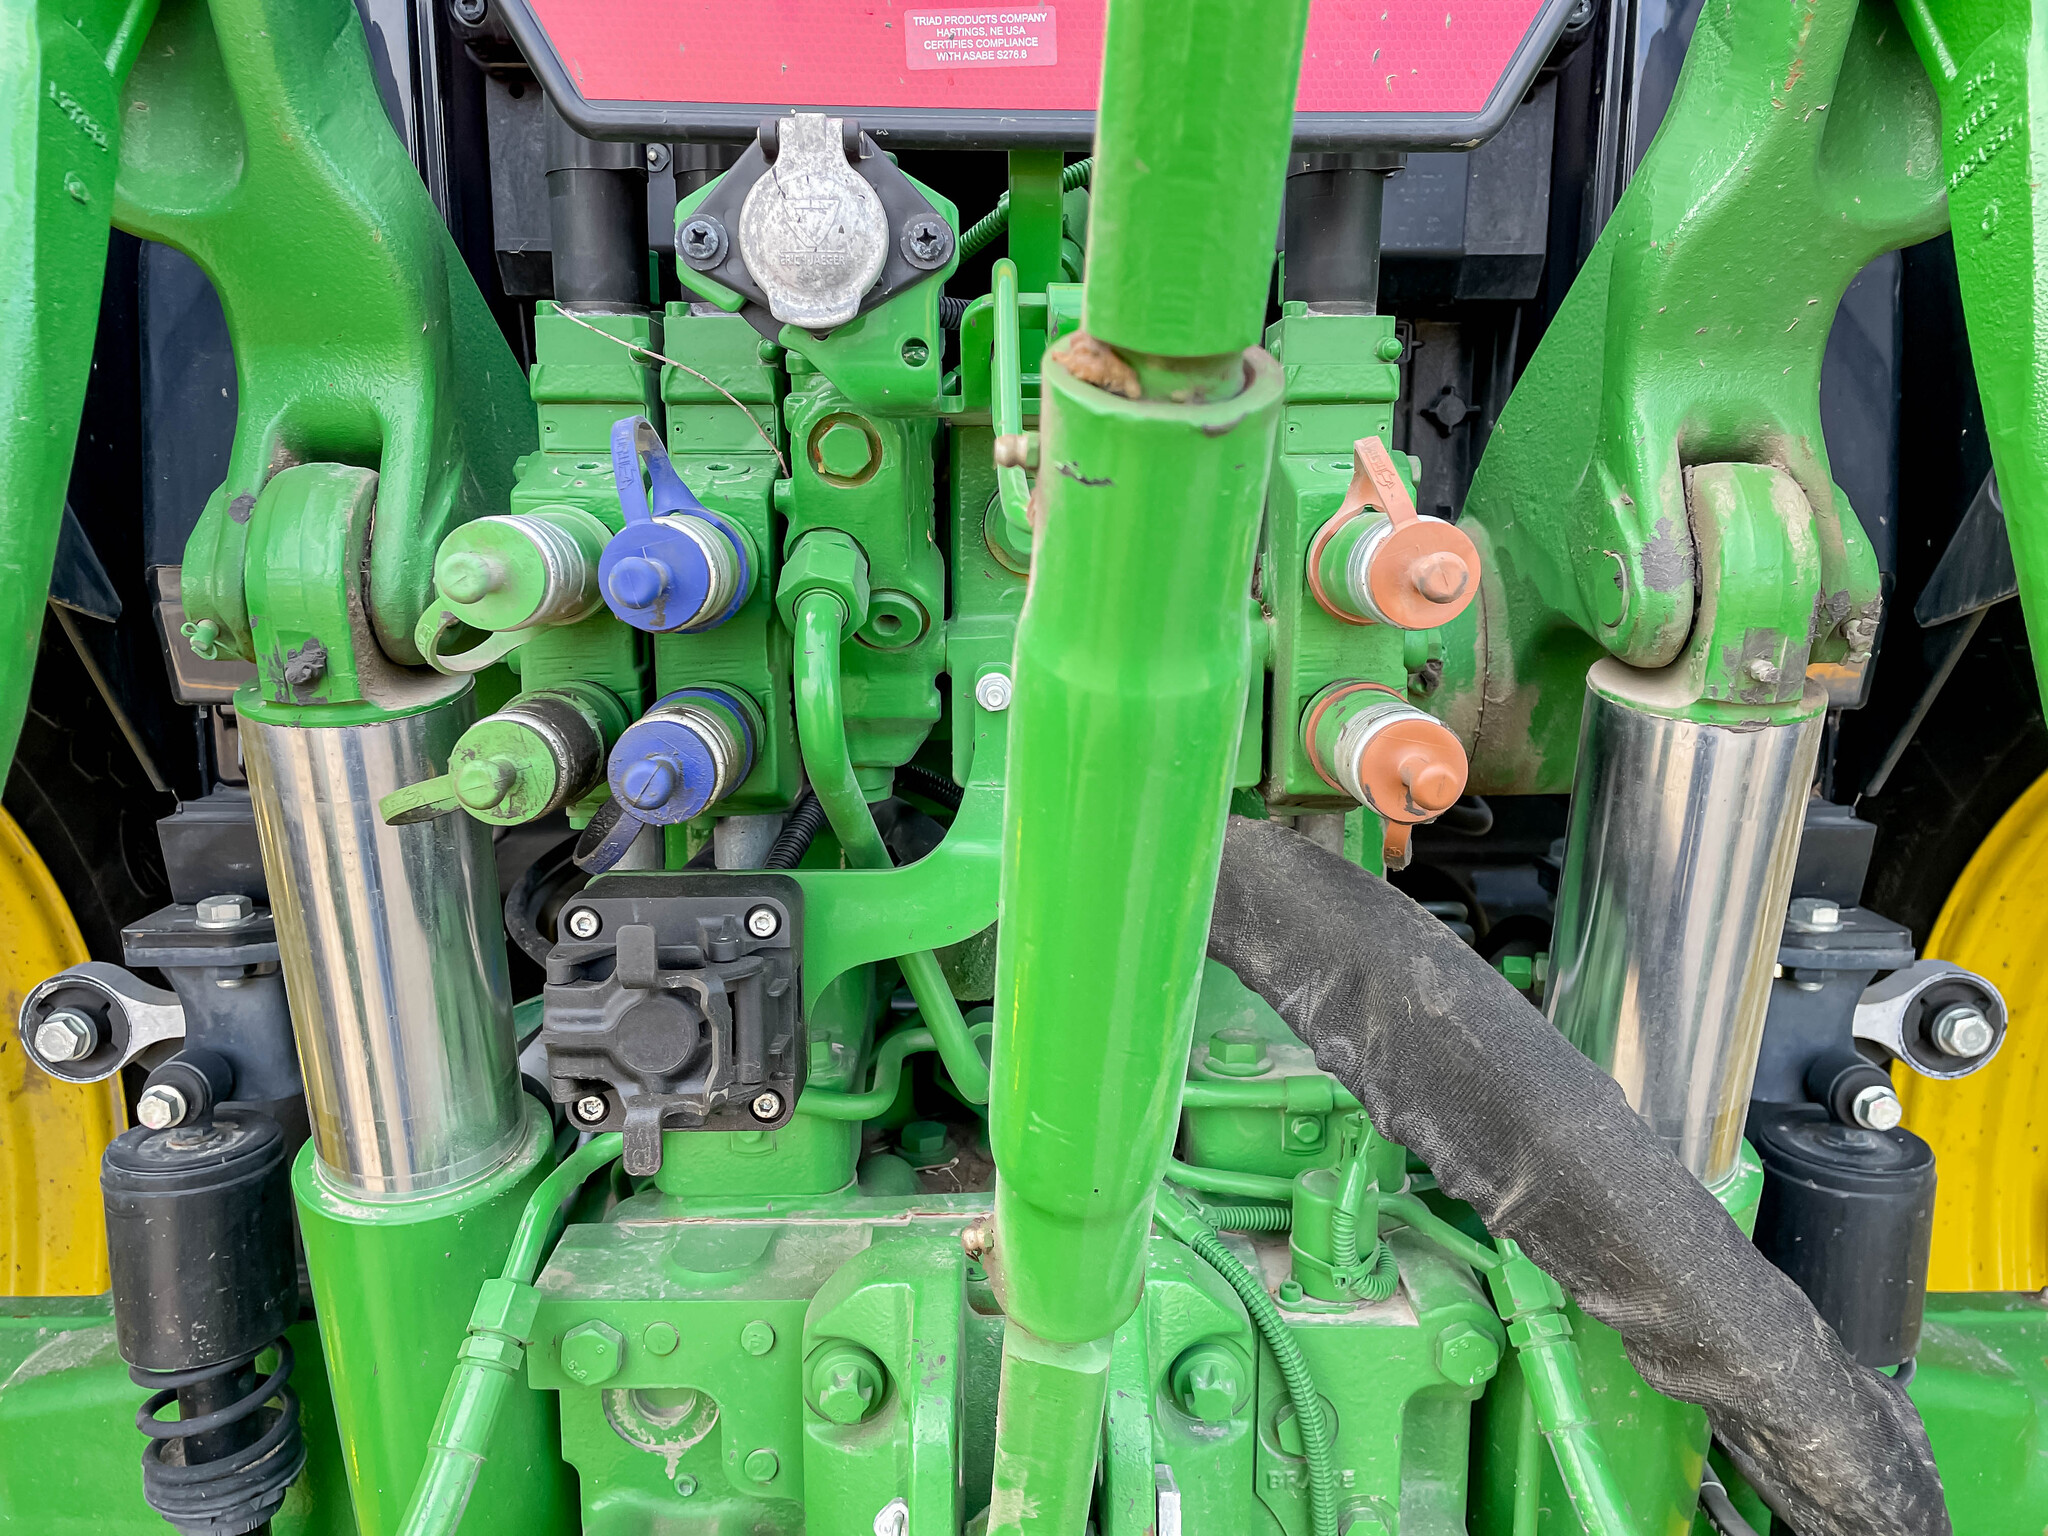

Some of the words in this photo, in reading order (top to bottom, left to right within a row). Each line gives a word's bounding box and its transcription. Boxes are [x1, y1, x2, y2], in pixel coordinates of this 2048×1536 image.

[913, 16, 942, 26] TRIAD
[944, 14, 998, 25] PRODUCTS
[999, 12, 1048, 24] COMPANY
[936, 27, 988, 38] HASTINGS,
[990, 26, 1004, 36] NE
[1005, 25, 1026, 36] USA
[924, 39, 974, 50] CERTIFIES
[976, 37, 1039, 48] COMPLIANCE
[936, 52, 961, 61] WITH
[962, 51, 995, 61] ASABE
[996, 49, 1028, 60] S276.8
